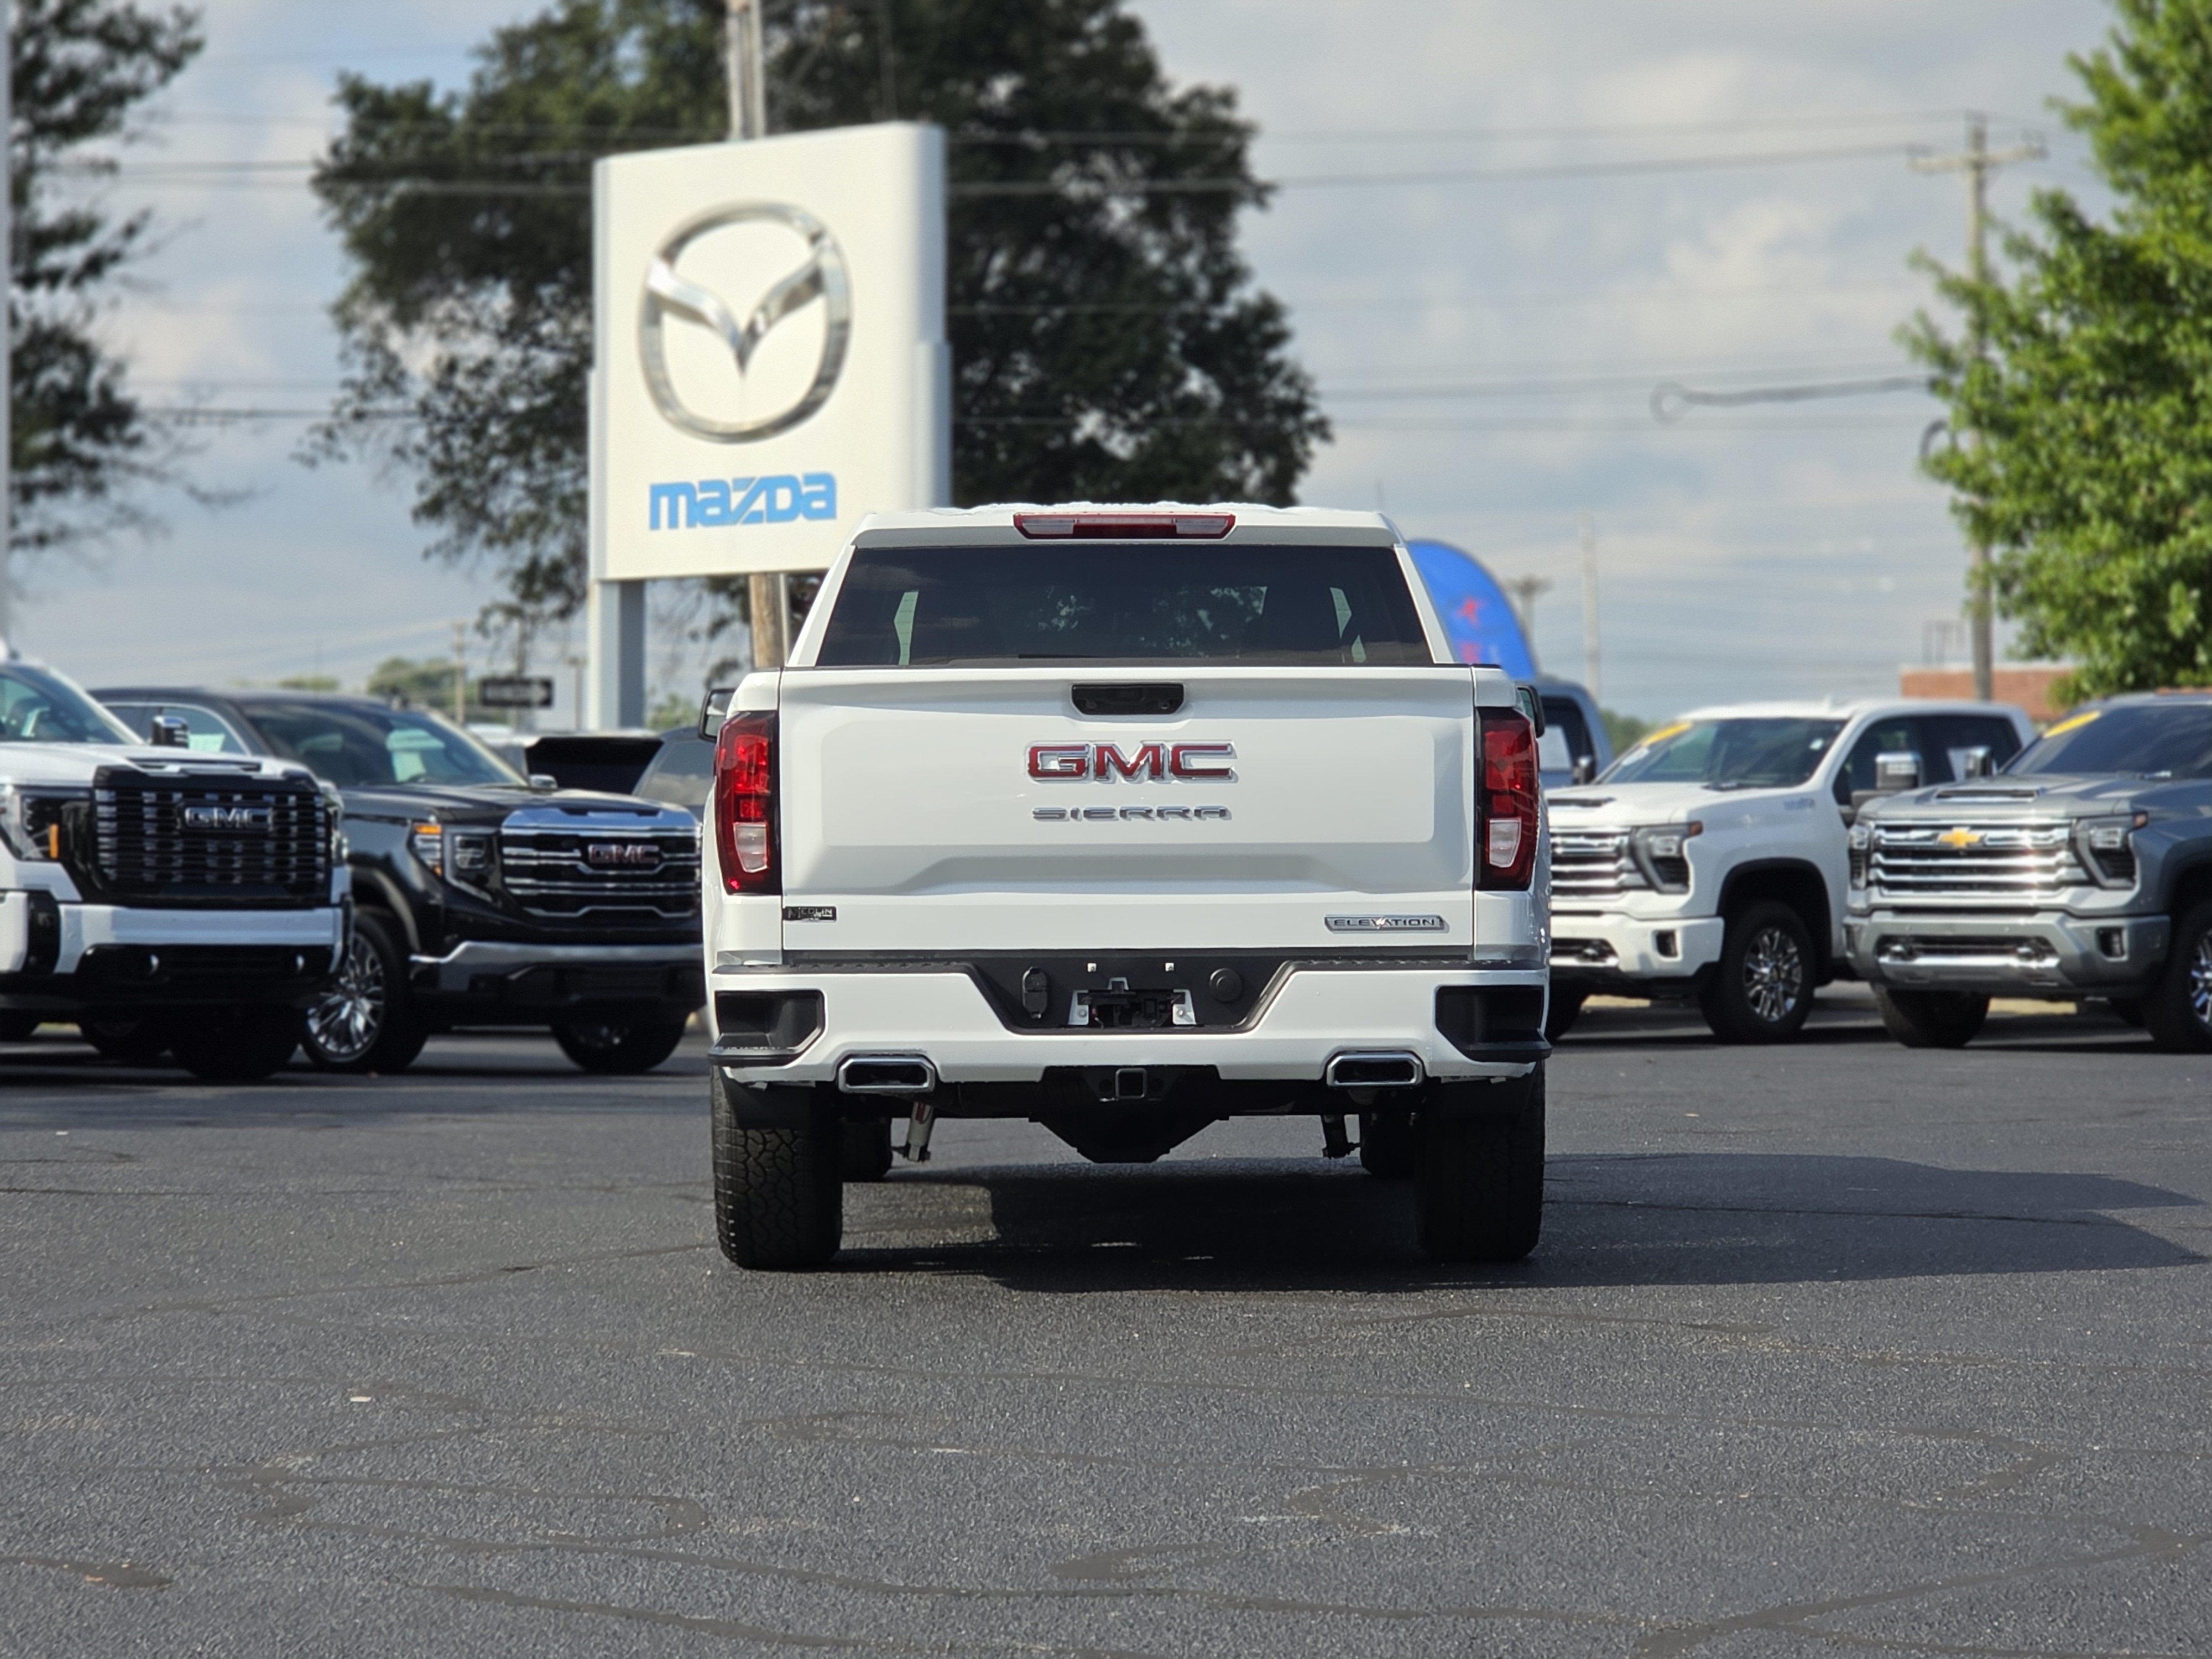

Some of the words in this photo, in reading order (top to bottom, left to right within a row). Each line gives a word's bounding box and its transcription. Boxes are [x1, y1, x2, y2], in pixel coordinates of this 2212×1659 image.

[1028, 743, 1232, 780] GMC
[185, 807, 270, 828] GMC
[1032, 806, 1228, 820] SIERRA
[588, 844, 659, 864] GMC
[1334, 918, 1434, 927] ELEVATION
